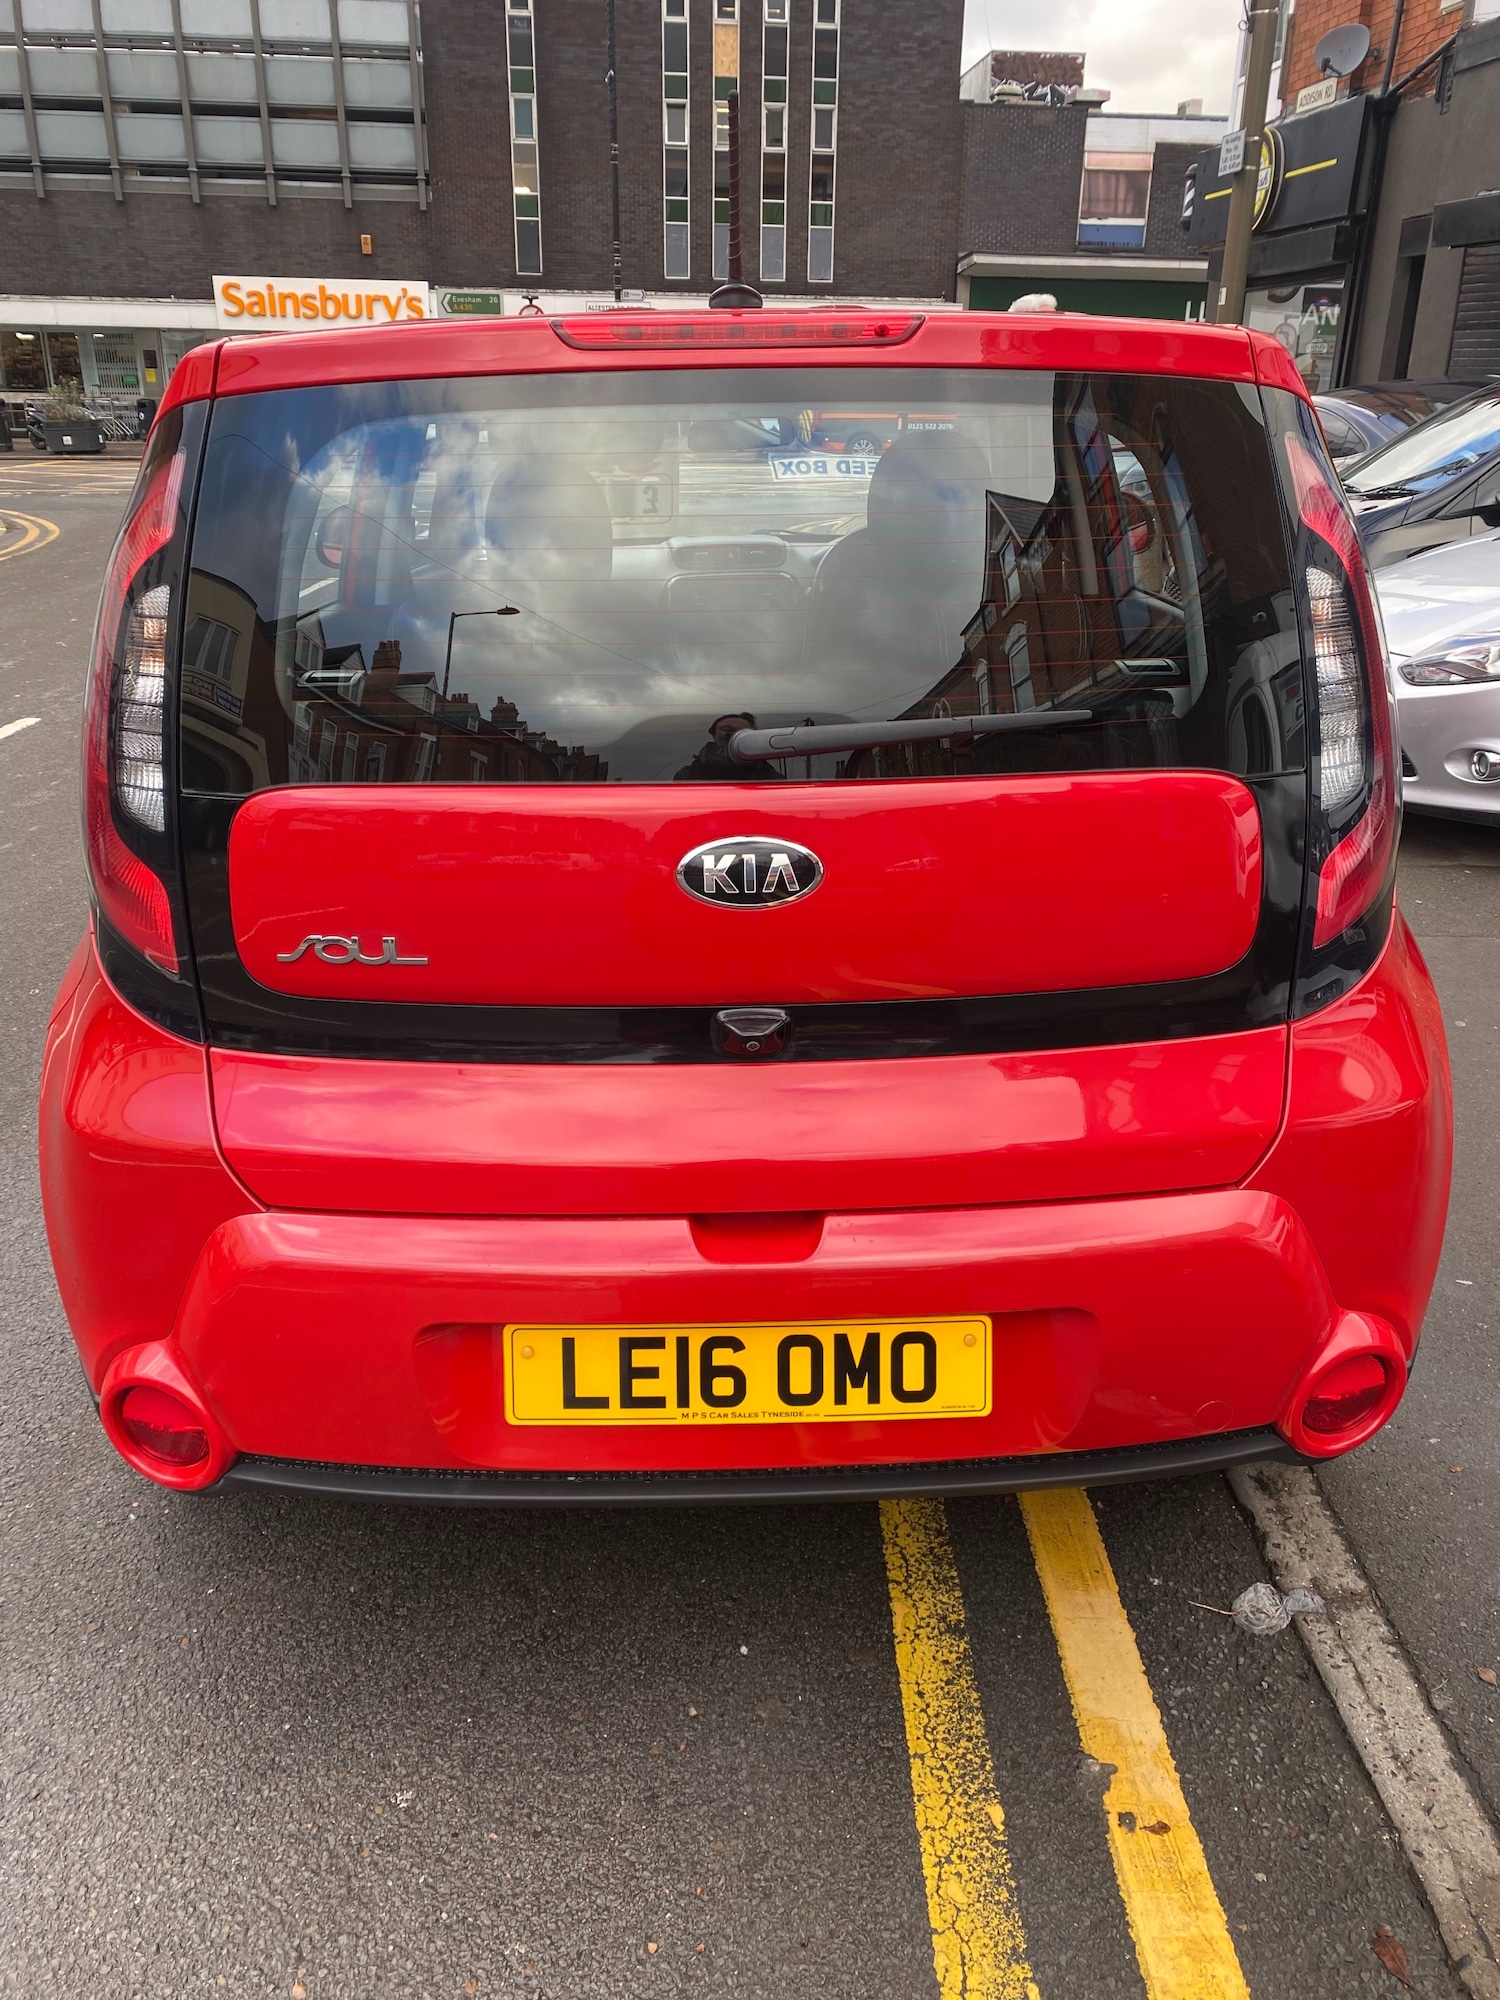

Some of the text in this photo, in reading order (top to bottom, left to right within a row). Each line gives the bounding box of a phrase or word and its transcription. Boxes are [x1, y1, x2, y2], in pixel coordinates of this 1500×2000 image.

[1299, 84, 1333, 108] ADDISON RD
[221, 281, 424, 320] Sainsbury's
[452, 295, 482, 303] Evesham
[702, 853, 801, 893] KIA
[277, 935, 429, 965] SOUL
[562, 1331, 937, 1409] LE16 OMO
